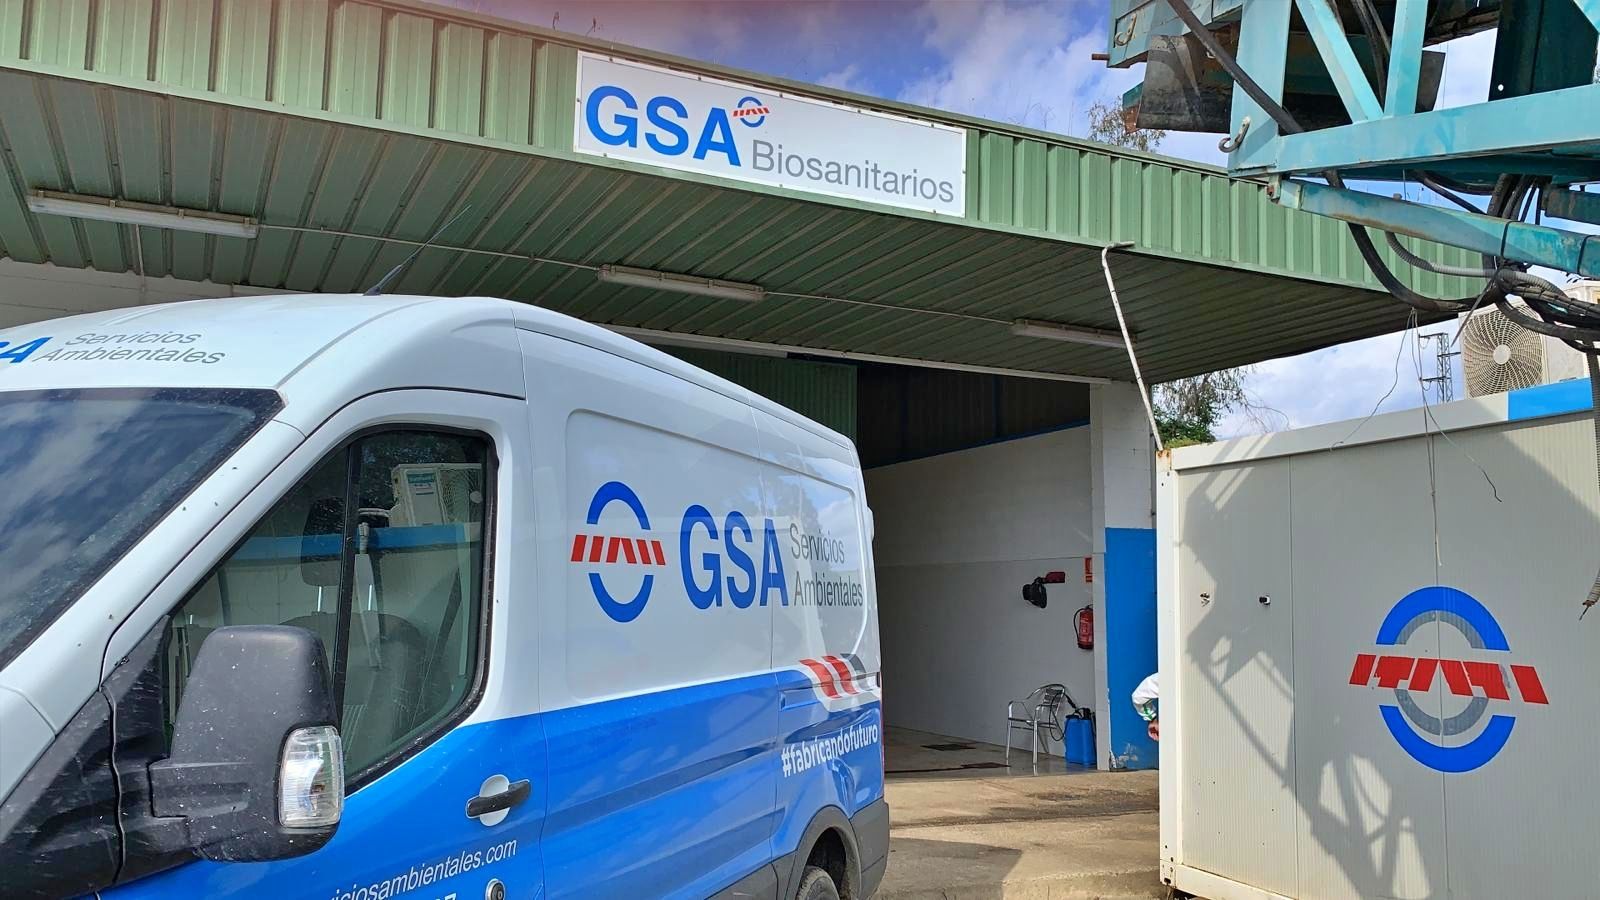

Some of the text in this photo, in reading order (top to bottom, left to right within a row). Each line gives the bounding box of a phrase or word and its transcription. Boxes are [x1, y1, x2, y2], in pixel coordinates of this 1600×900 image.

[585, 85, 954, 203] GSA Biosanitarios
[0, 336, 53, 363] A
[32, 347, 226, 364] Ambientales
[65, 331, 202, 346] Servicios
[679, 504, 789, 610] GSA
[789, 523, 845, 565] Servicios
[793, 570, 864, 607] Ambientales
[781, 723, 878, 778] #fabricandofuturo
[331, 839, 517, 900] iciosambientales.com
